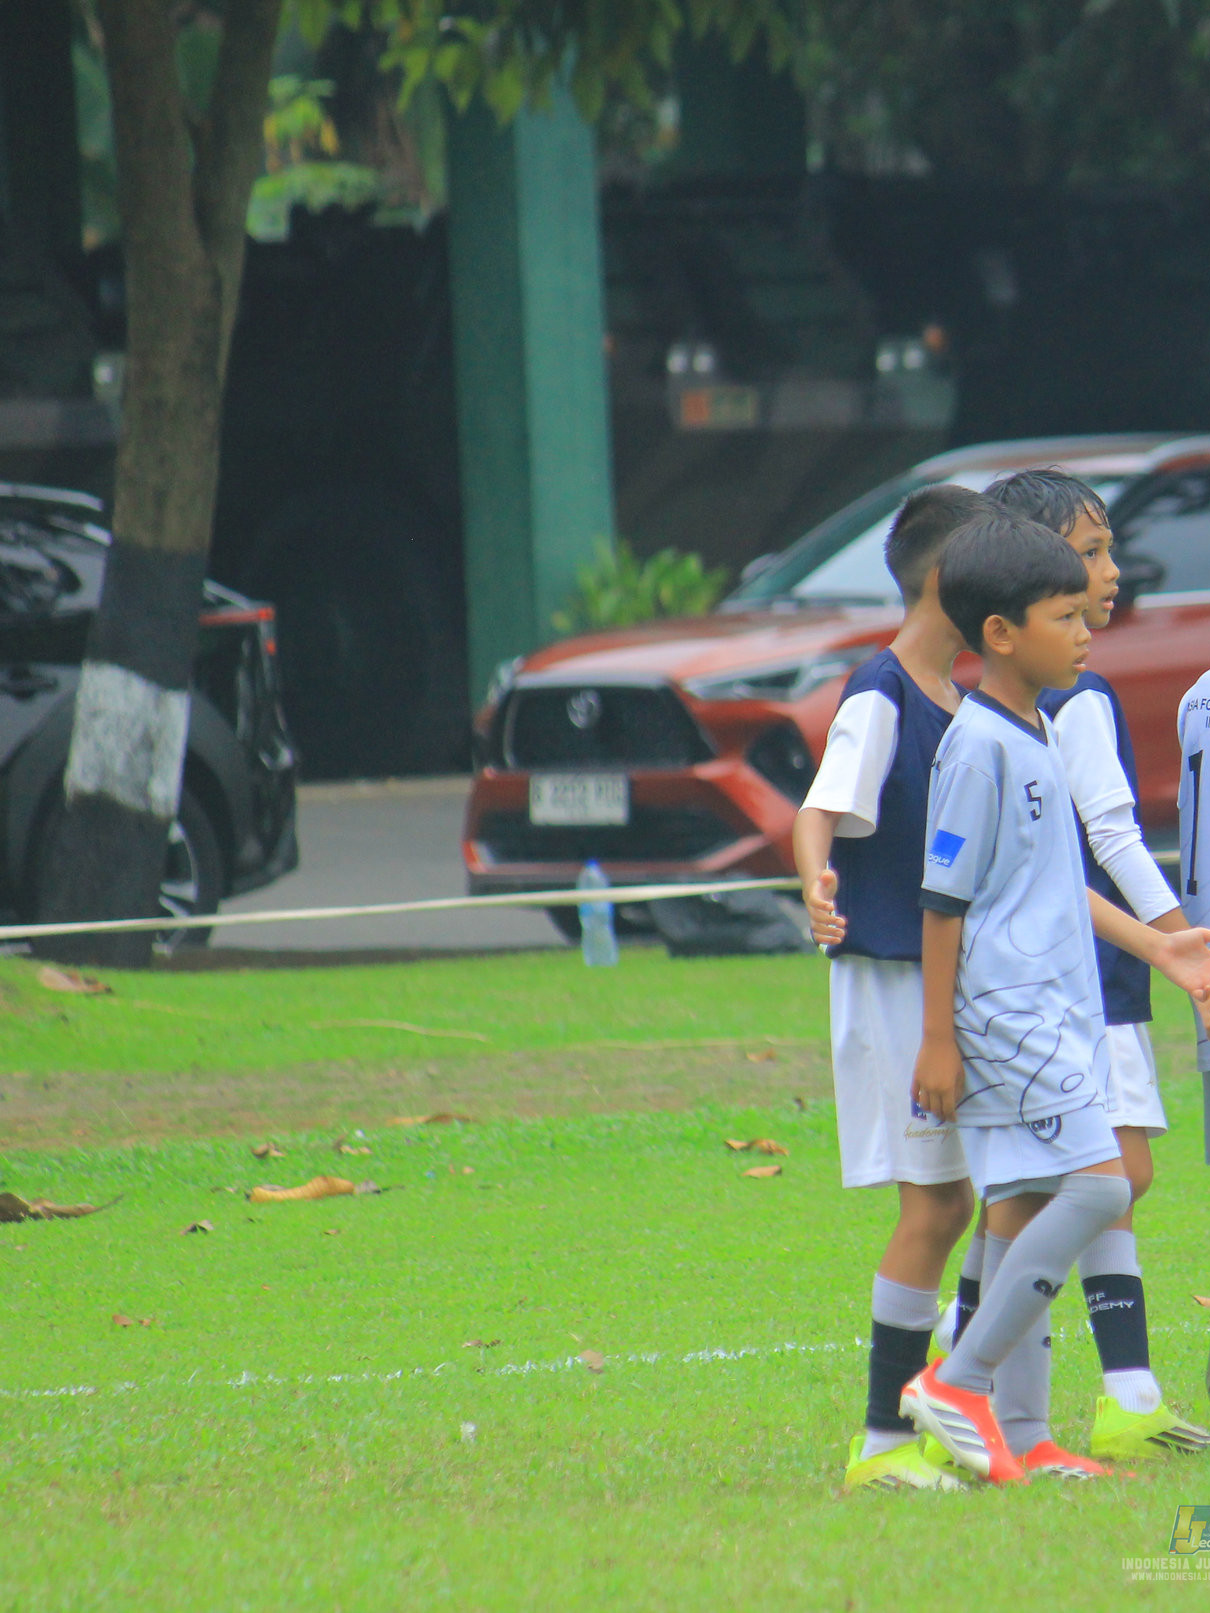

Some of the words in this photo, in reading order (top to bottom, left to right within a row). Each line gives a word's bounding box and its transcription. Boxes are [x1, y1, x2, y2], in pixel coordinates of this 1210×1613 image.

[1023, 780, 1042, 822] 5
[928, 853, 951, 867] ague
[1090, 1300, 1135, 1313] DEMY
